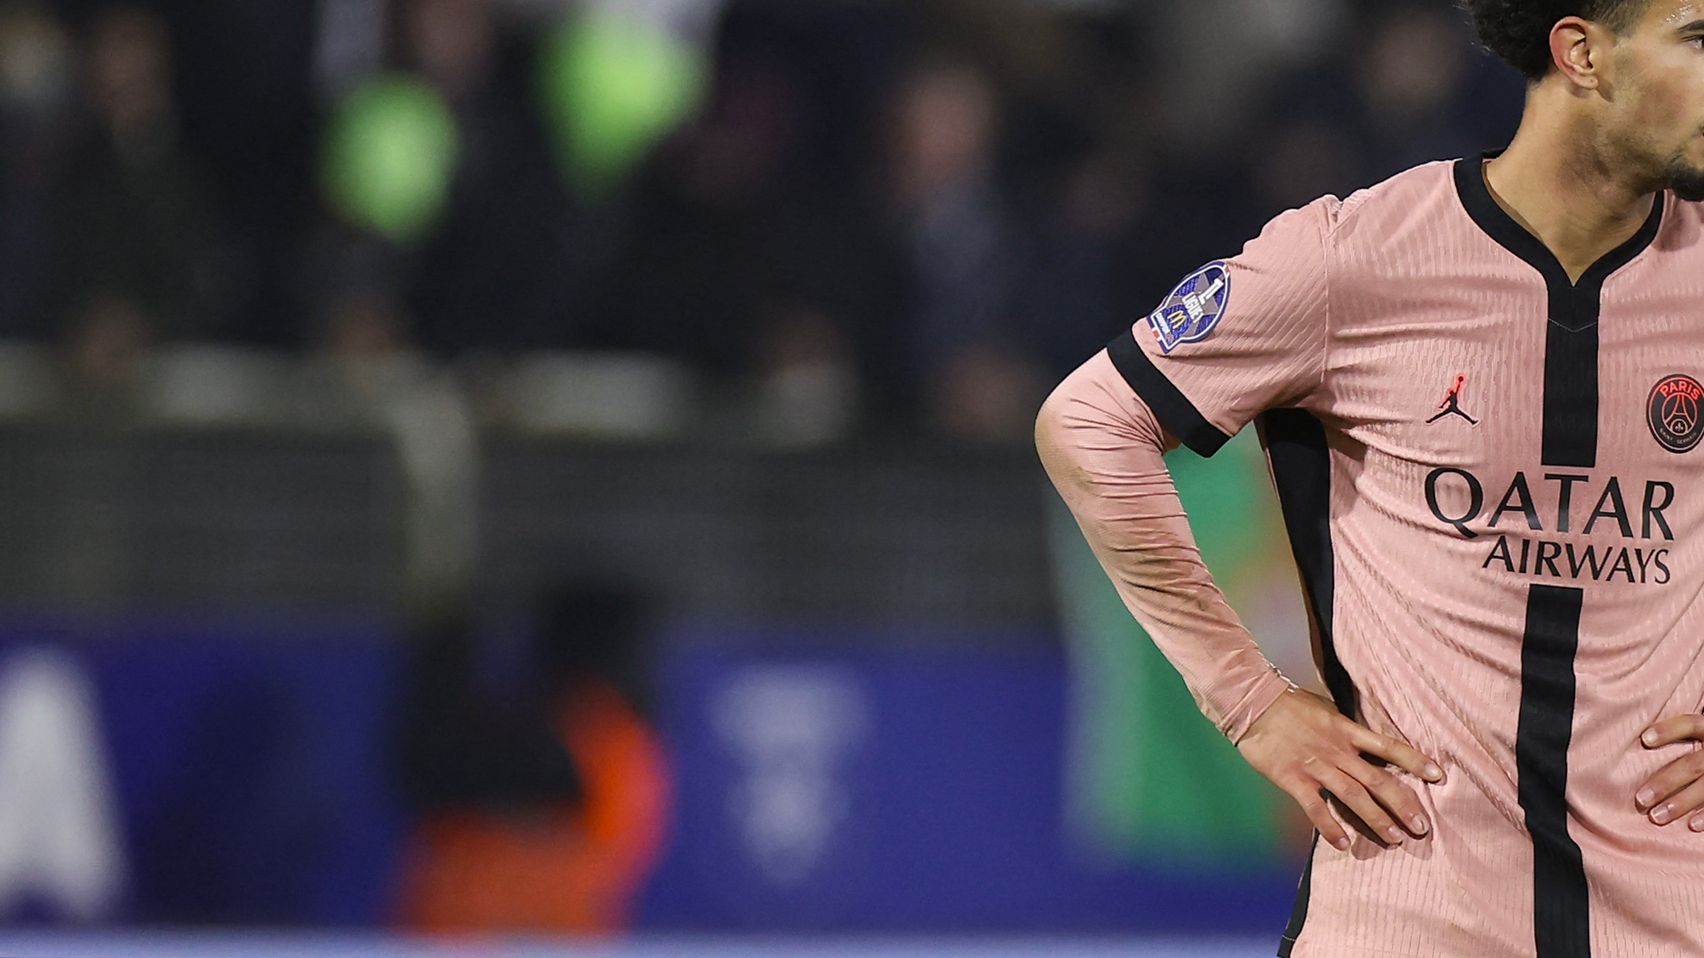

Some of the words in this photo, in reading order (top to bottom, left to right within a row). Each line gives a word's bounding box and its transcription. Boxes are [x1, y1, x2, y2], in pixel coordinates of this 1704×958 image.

[1660, 381, 1700, 400] PARIS
[1424, 467, 1675, 541] QATAR
[1482, 535, 1671, 584] AIRWAYS
